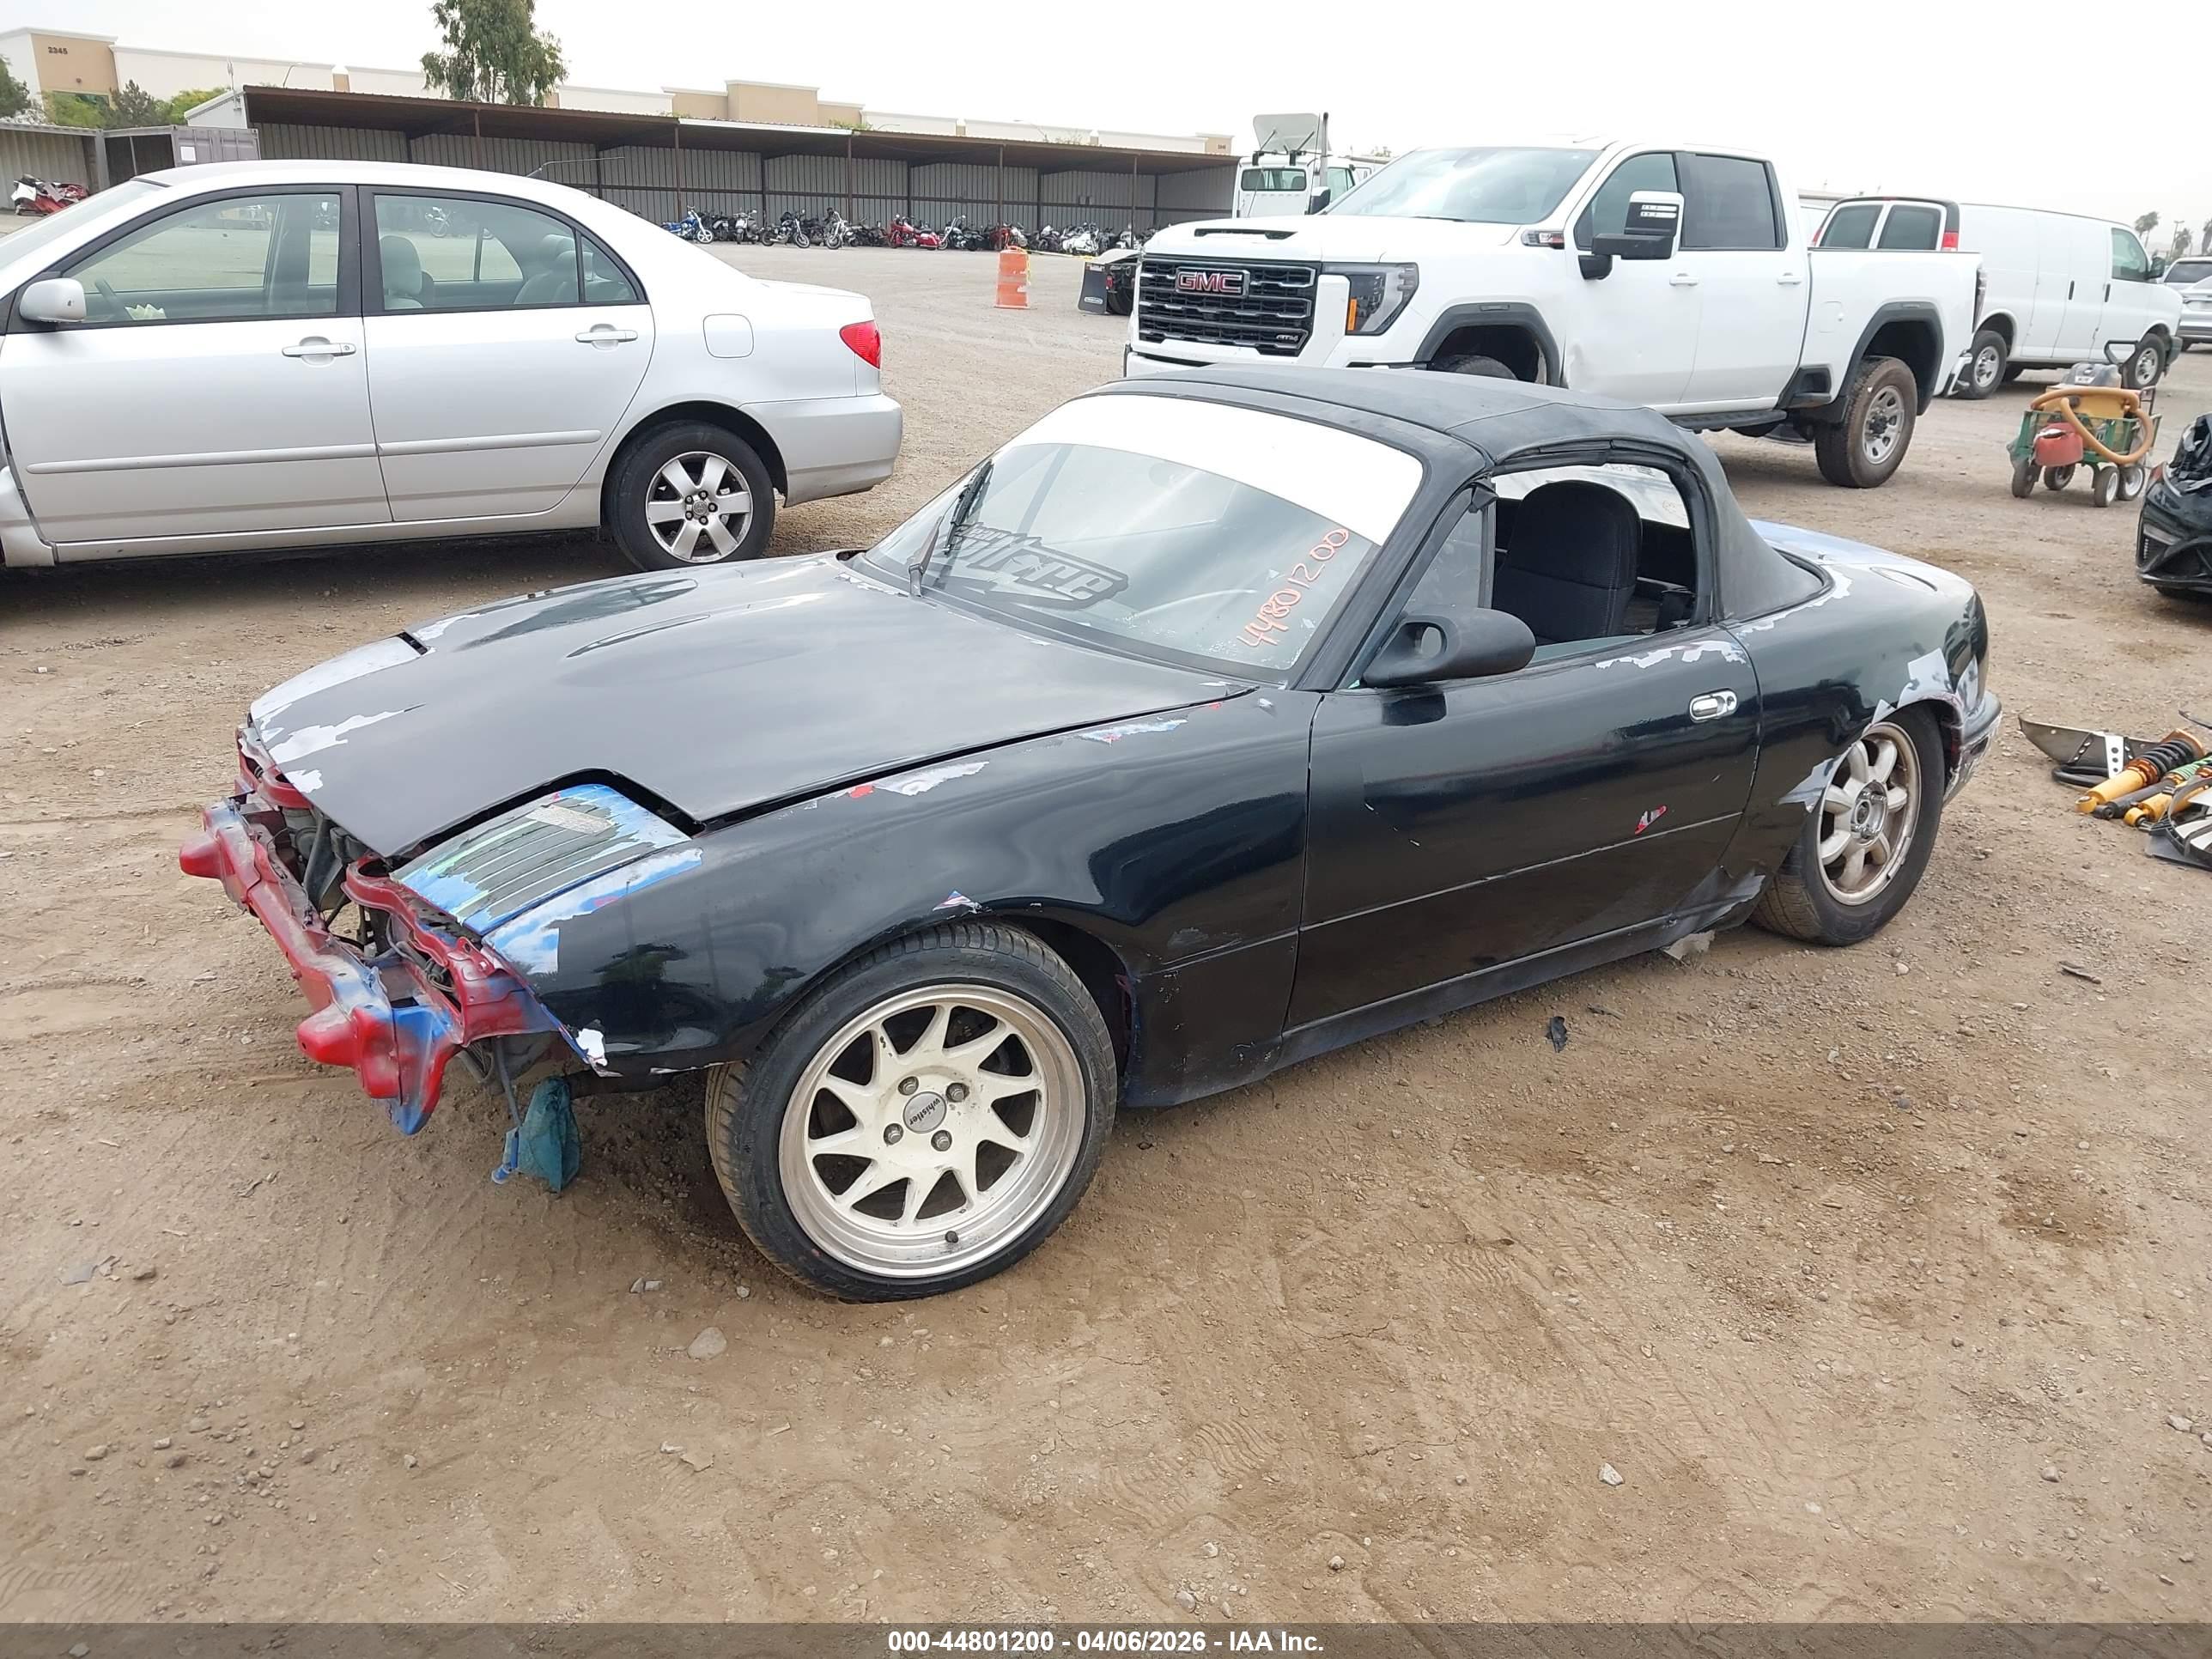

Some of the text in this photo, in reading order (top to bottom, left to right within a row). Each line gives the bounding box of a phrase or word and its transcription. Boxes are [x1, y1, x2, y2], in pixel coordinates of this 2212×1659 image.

[1177, 271, 1243, 294] GMC
[1237, 528, 1349, 647] 44801200
[909, 1098, 940, 1125] whistler
